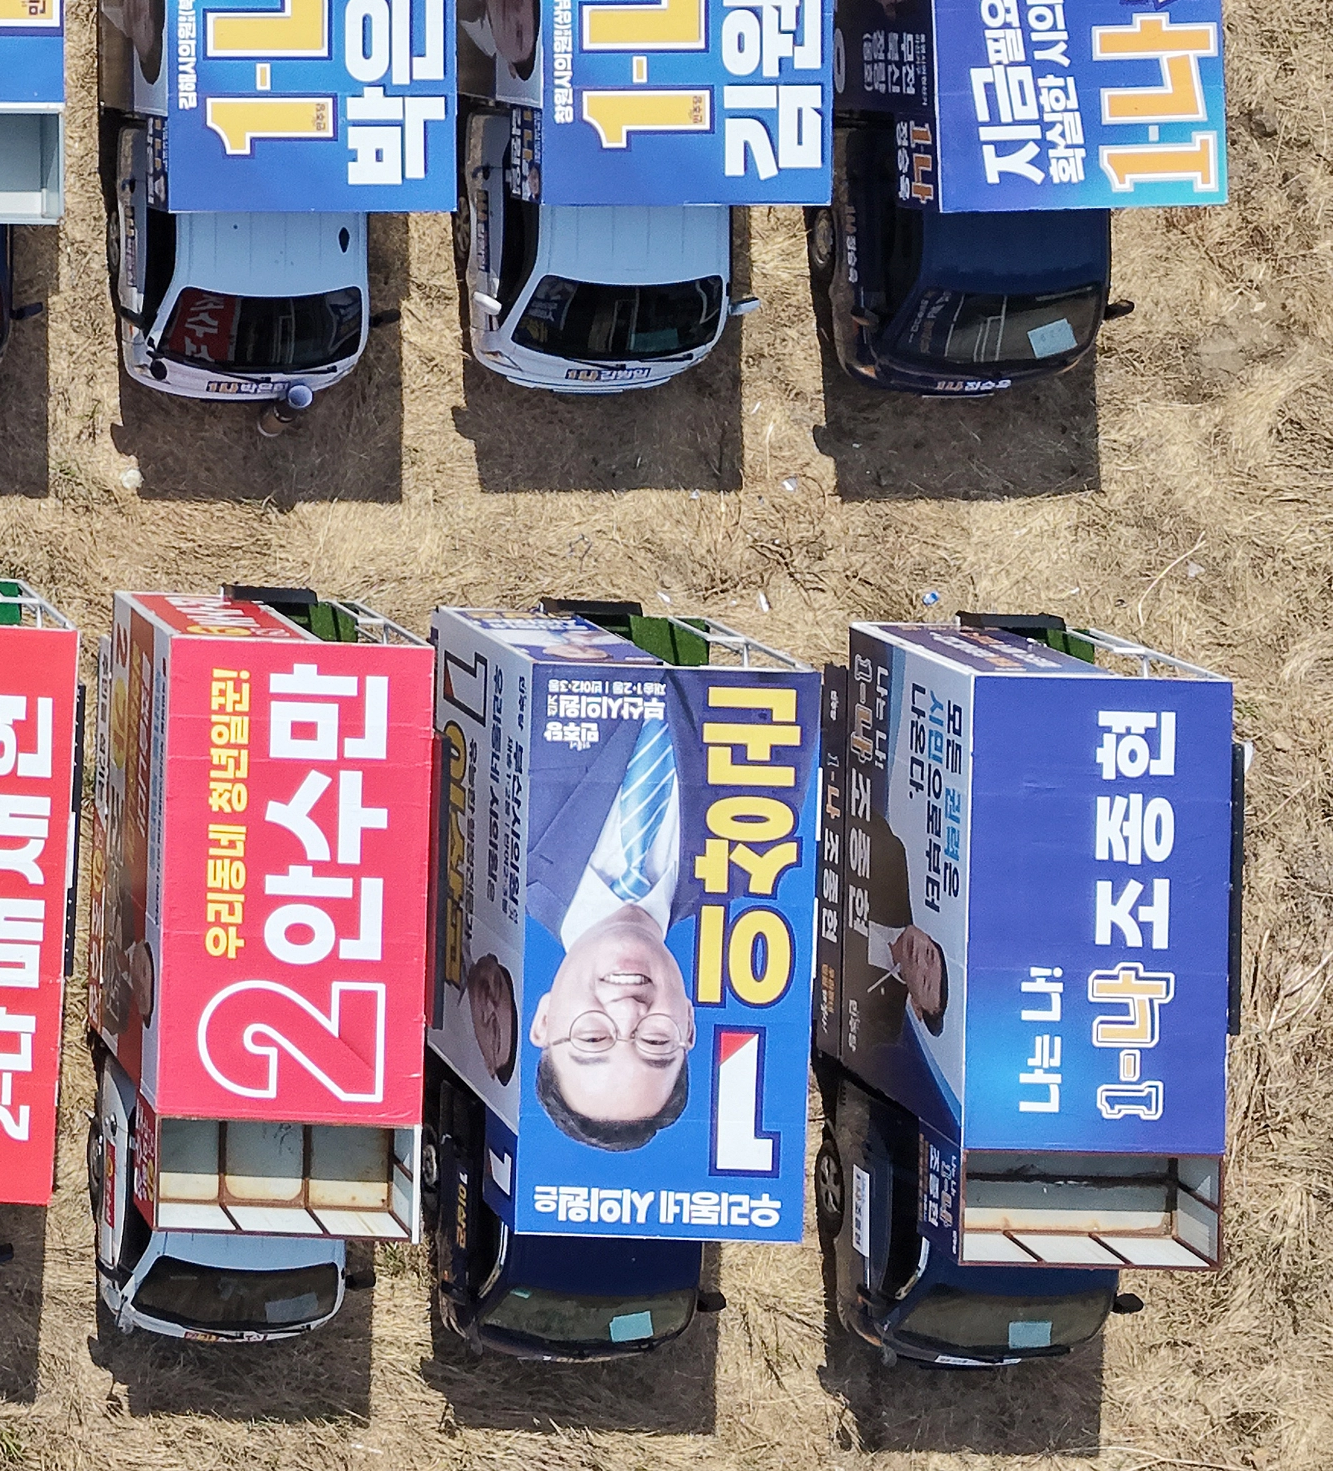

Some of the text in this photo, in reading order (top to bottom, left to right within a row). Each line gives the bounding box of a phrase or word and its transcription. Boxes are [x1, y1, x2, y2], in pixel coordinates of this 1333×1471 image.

[1040, 76, 1087, 184] 확실한
[1091, 13, 1220, 192] 1-나
[544, 722, 599, 741] 민주당
[875, 667, 888, 768] 나는 나!
[909, 682, 925, 799] 나온다.
[943, 700, 962, 899] 모든 권력은
[197, 663, 389, 1103] 2 안수만
[204, 668, 250, 959] 우리동네 청년일꾼!
[510, 742, 522, 906] 부산시의원
[694, 686, 801, 1005] 이상곤
[849, 767, 871, 937] 조종현
[924, 690, 944, 913] 시민으로부터
[1087, 711, 1176, 1120] 1-나 조종현
[1019, 967, 1064, 1112] 나는 나!
[490, 1149, 511, 1196] 1
[533, 1186, 783, 1226] 우리동네 시의원은
